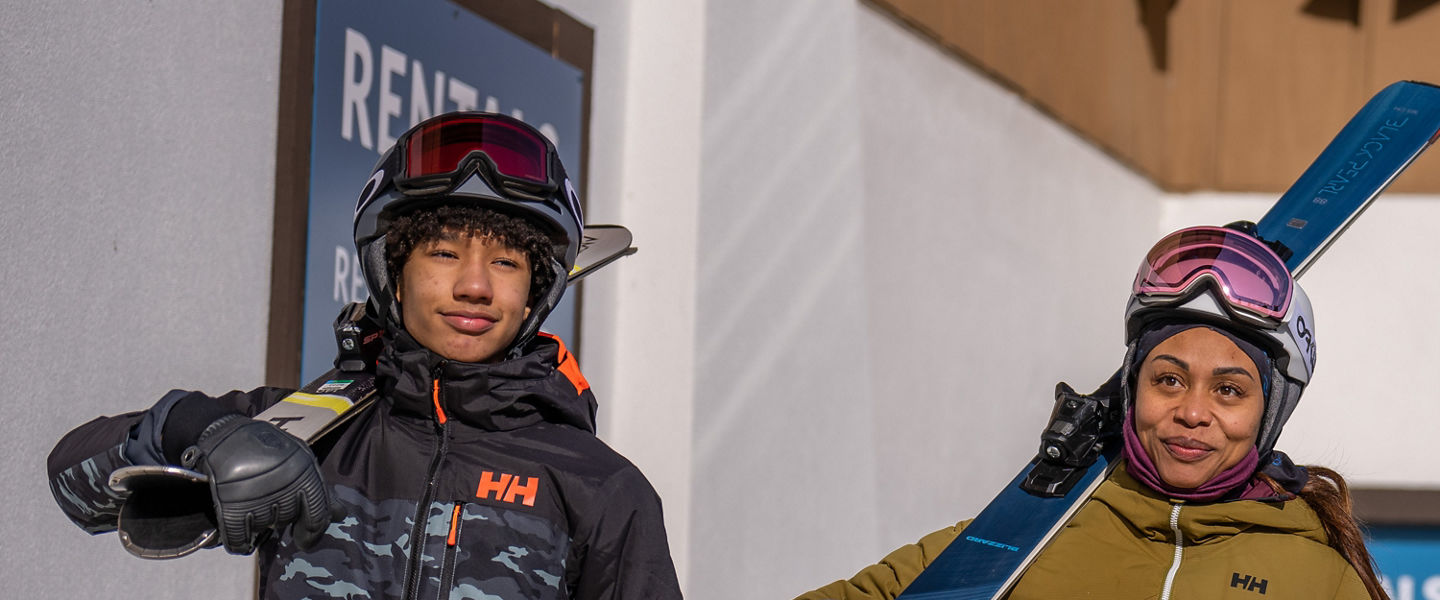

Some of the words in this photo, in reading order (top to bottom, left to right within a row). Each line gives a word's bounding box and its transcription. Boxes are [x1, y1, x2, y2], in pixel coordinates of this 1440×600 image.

[342, 28, 560, 156] RENT
[476, 471, 539, 507] HH
[966, 536, 1020, 552] BLIZZARD
[1230, 572, 1268, 595] HH
